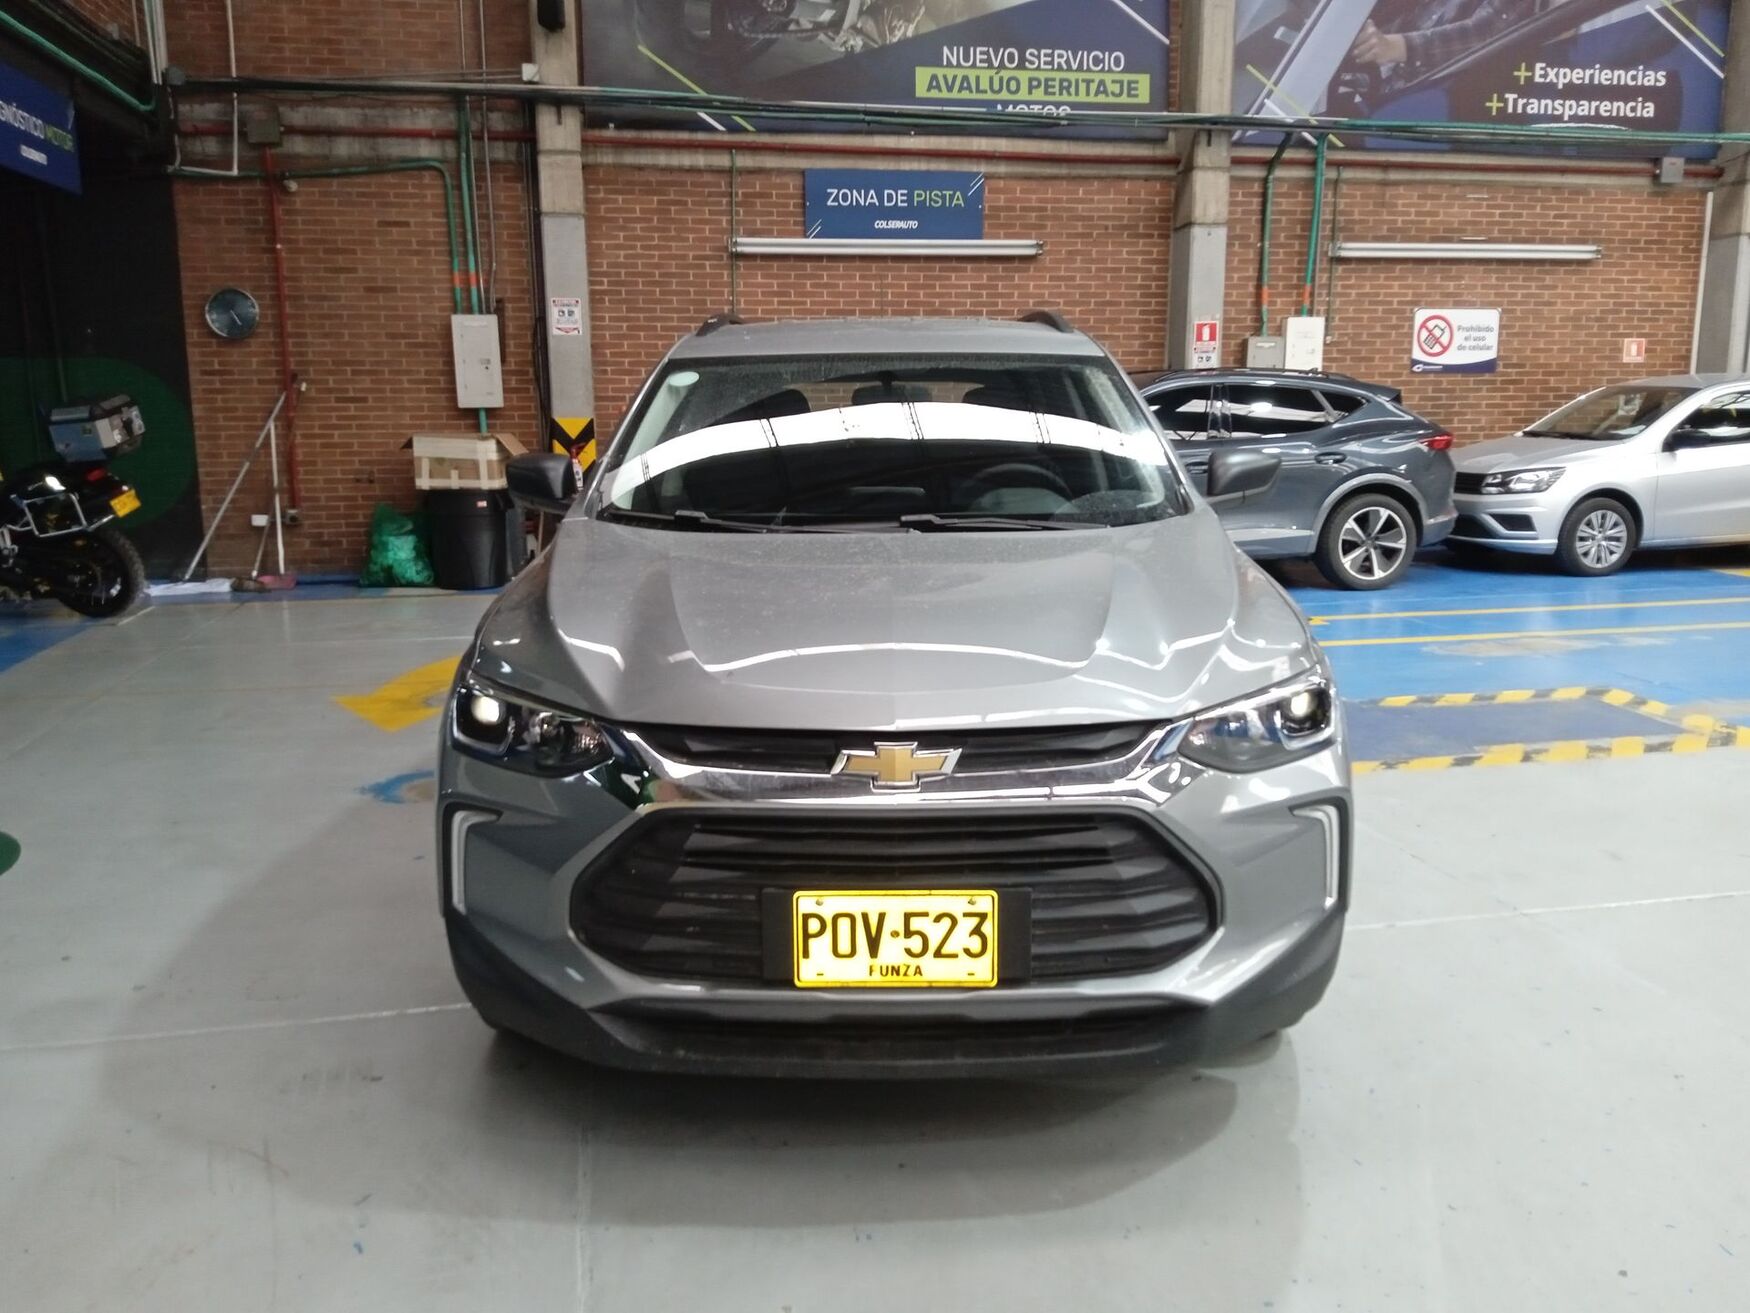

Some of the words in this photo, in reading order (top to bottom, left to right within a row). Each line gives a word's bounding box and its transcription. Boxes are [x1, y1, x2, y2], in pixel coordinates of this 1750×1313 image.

[943, 46, 1019, 68] NUEVO
[1025, 48, 1126, 72] SERVICIO
[926, 69, 1021, 95] AVALÚO
[1027, 76, 1140, 98] PERITAJE
[826, 188, 879, 206] ZONA
[884, 189, 908, 207] DE
[914, 190, 965, 208] PISTA
[874, 220, 918, 229] COLSERAUTO
[1457, 325, 1495, 333] Prohibido
[1457, 343, 1467, 351] de
[1468, 343, 1494, 351] celular
[869, 964, 923, 977] FUNZA
